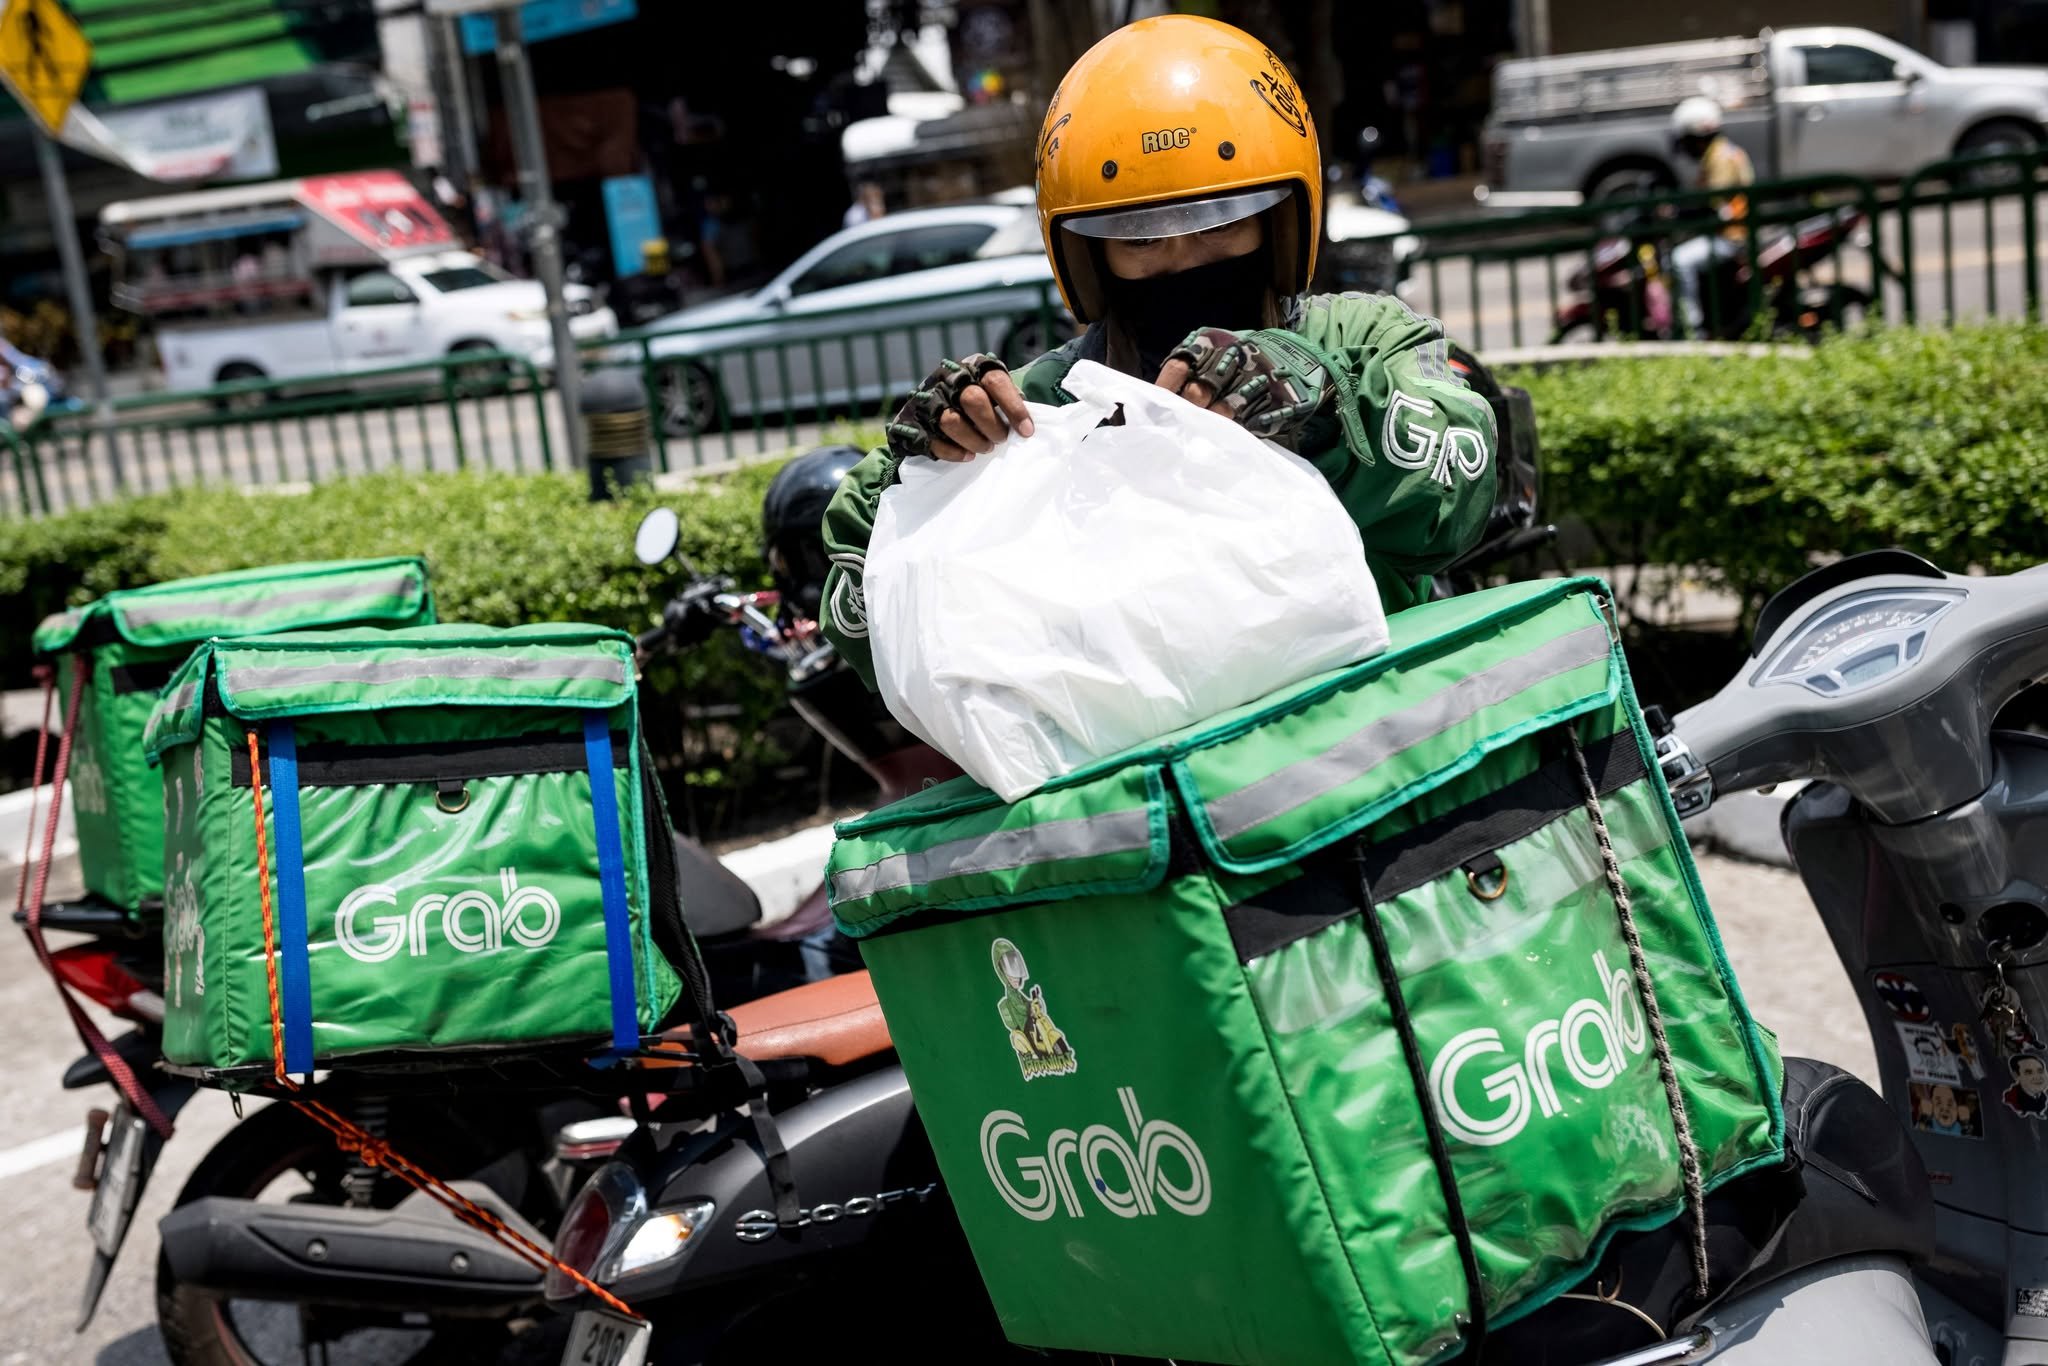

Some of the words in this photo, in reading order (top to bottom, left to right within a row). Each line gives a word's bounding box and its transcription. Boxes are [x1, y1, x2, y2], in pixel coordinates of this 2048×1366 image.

[334, 866, 562, 963] Grab
[1428, 949, 1646, 1146] Grab
[980, 1086, 1212, 1221] Grab
